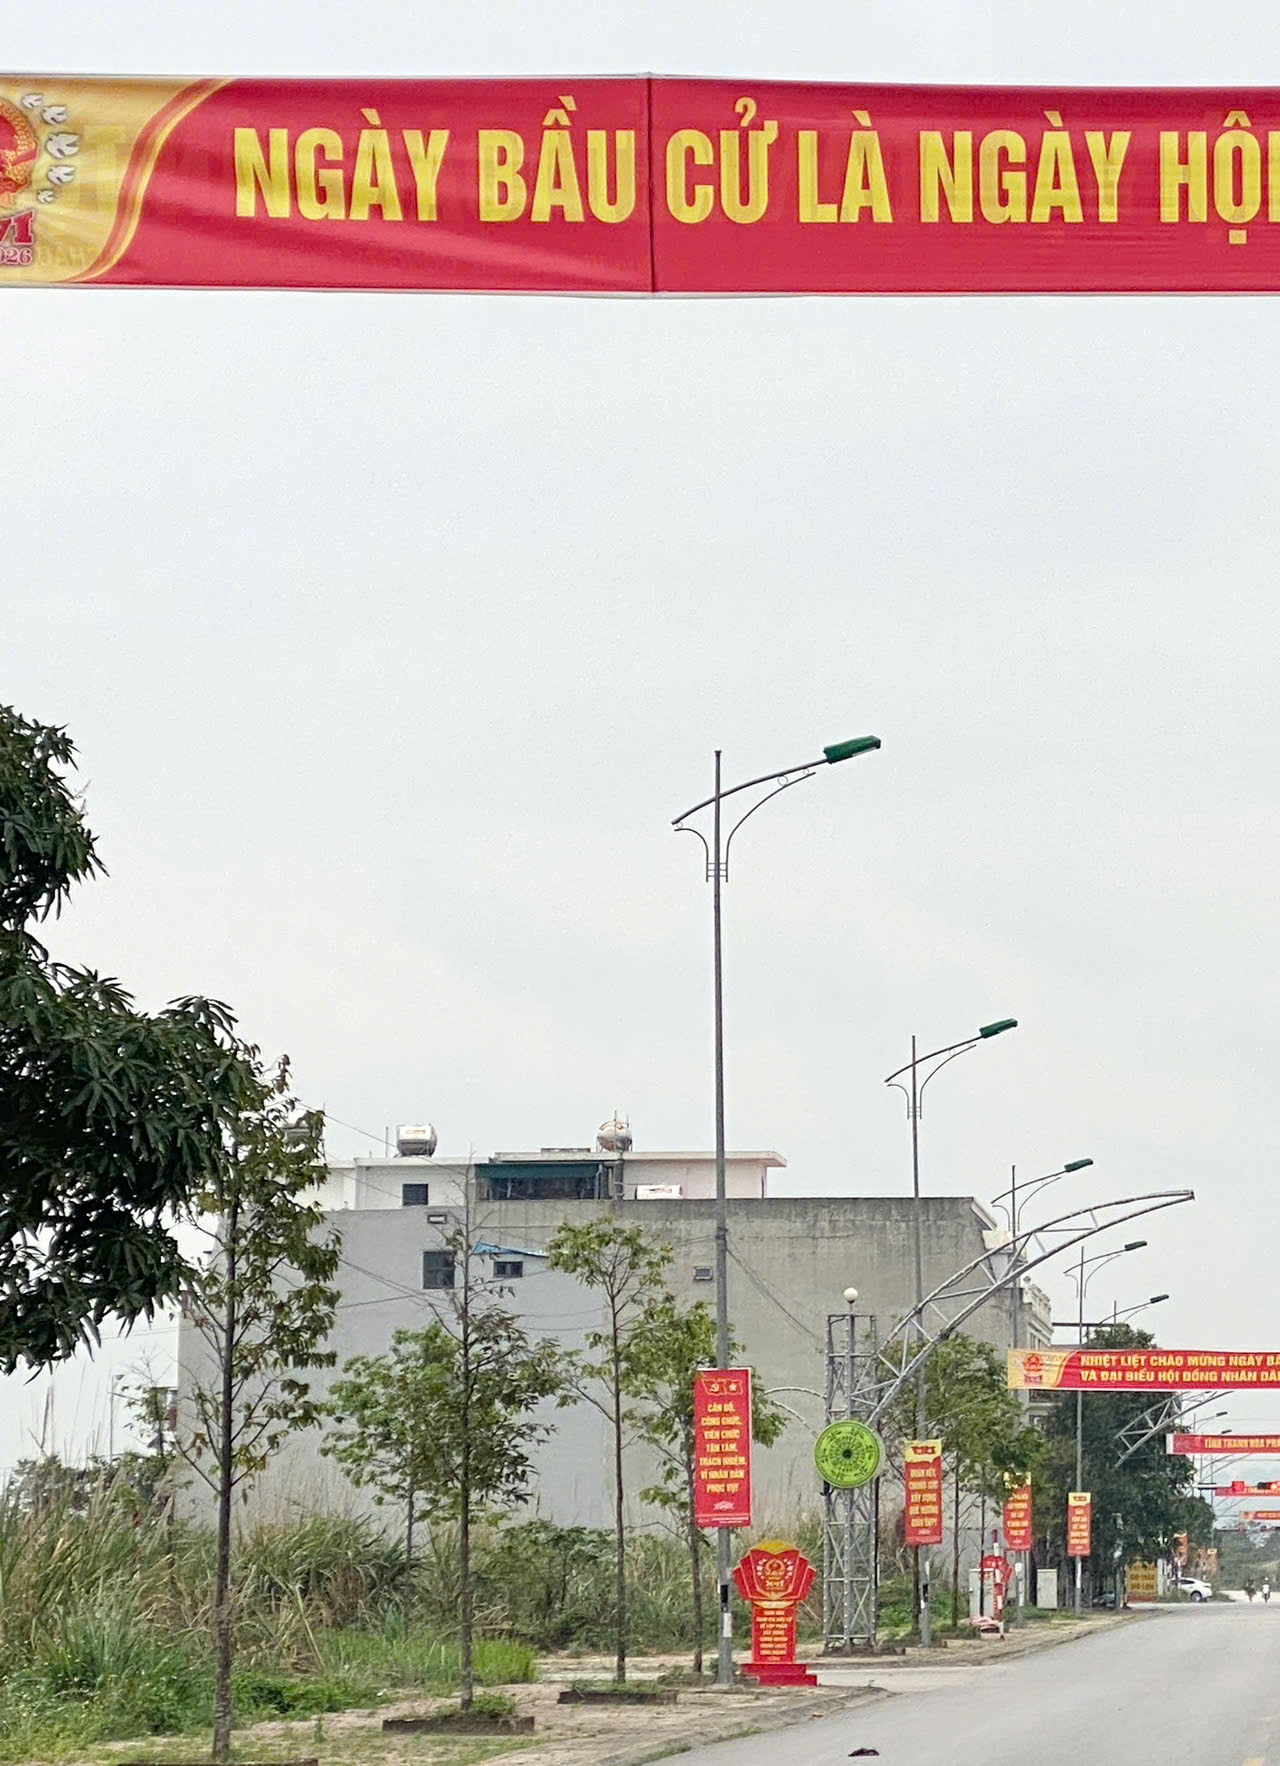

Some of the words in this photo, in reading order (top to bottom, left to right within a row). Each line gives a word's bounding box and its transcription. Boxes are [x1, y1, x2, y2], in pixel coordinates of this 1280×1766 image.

[234, 109, 449, 222] NGÀY
[478, 96, 637, 223] BẦU
[665, 97, 777, 224] CỬ
[798, 111, 893, 224] LÀ
[919, 111, 1131, 224] NGÀY
[1081, 1354, 1117, 1367] NHIỆT
[1120, 1354, 1146, 1367] LIỆT
[1150, 1353, 1183, 1366] CHÀO
[1229, 1353, 1262, 1367] NGÀY
[1158, 1370, 1178, 1383] HỘI
[1221, 1370, 1257, 1382] NHÂN
